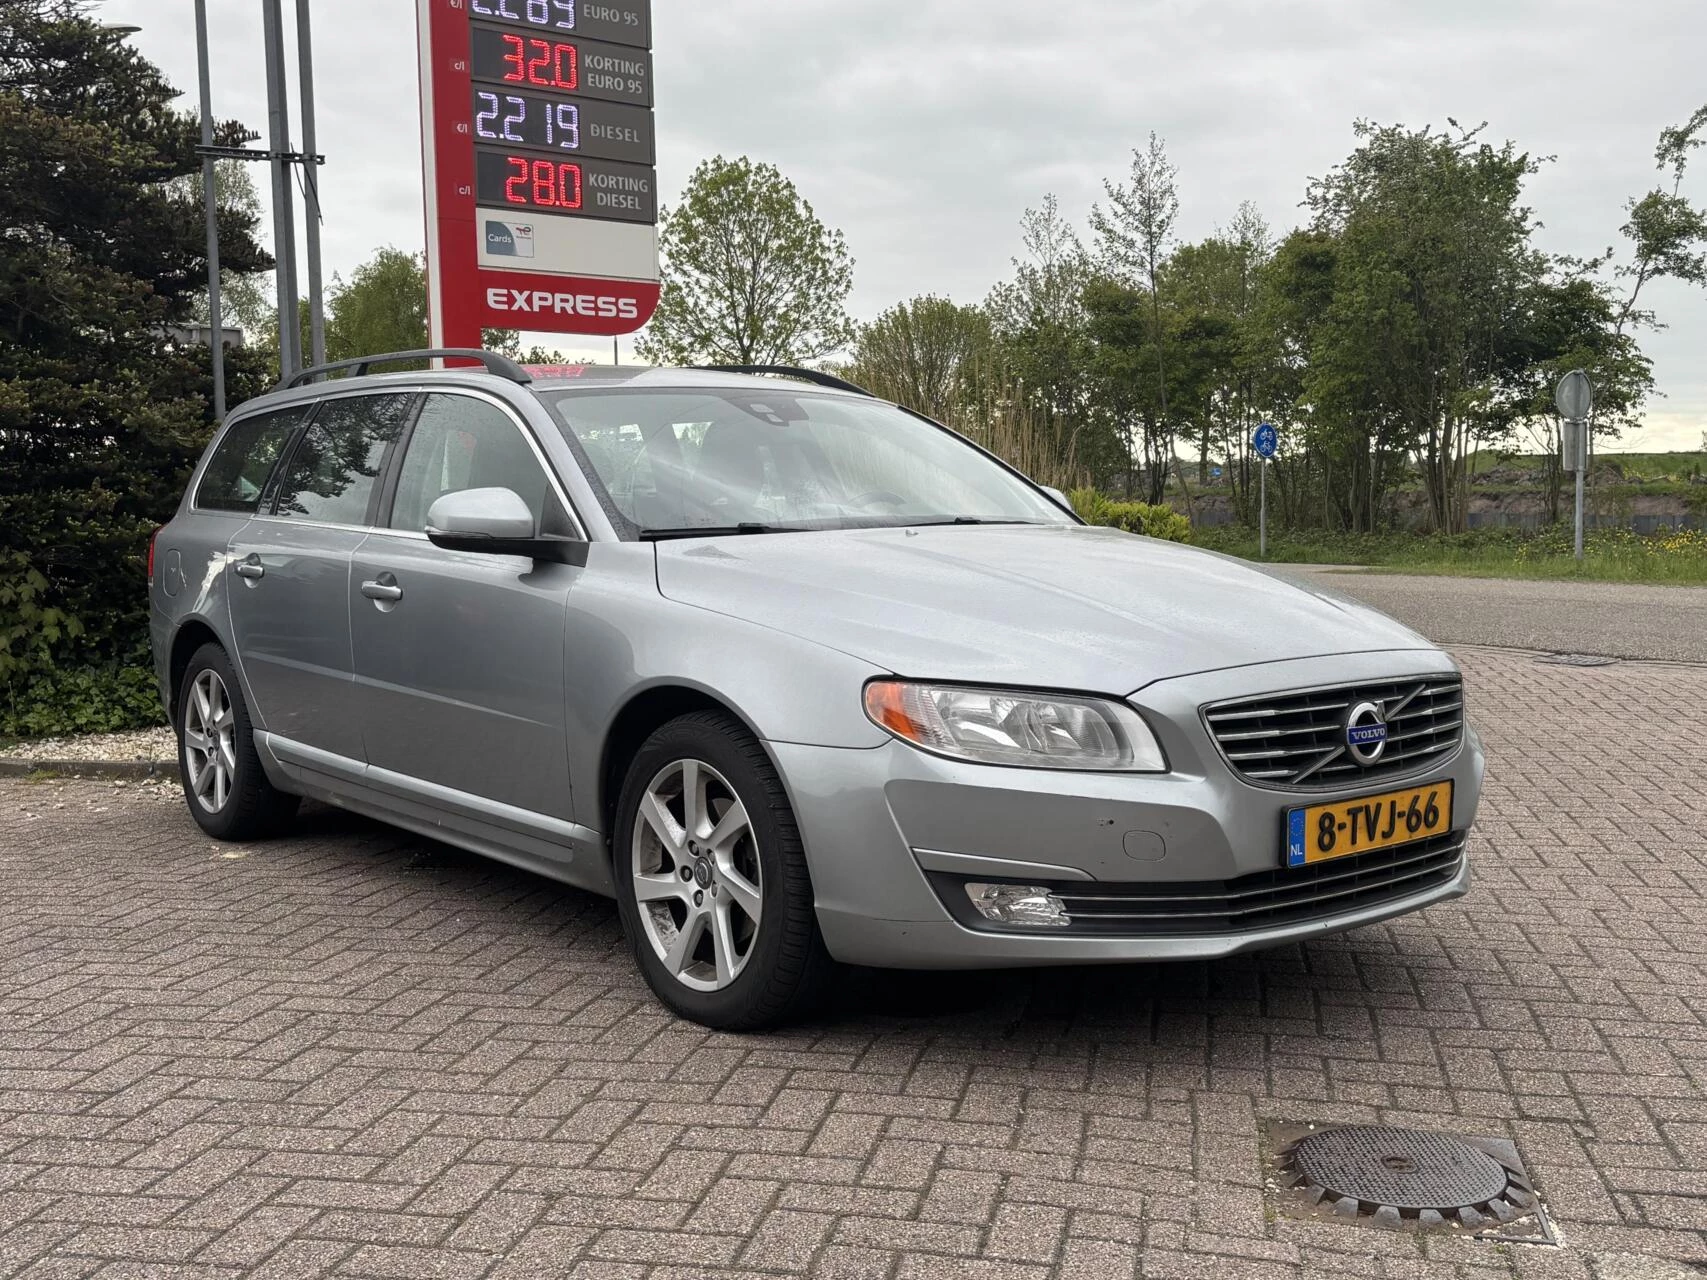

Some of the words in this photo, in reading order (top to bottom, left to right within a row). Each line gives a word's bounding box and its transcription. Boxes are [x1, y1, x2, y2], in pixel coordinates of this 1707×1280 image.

[583, 3, 620, 23] EURO
[623, 9, 639, 26] 95
[503, 34, 577, 90] 32.0
[584, 54, 645, 77] KORTING
[587, 73, 624, 92] EURO
[627, 78, 642, 94] 95
[476, 92, 580, 149] 2.219
[590, 123, 641, 143] DIESEL
[506, 156, 582, 208] 28.0
[588, 173, 649, 193] KORTING
[596, 192, 642, 210] DIESEL
[488, 233, 512, 244] Cards
[486, 288, 638, 319] EXPRESS
[1351, 728, 1386, 740] VOLVO
[1317, 791, 1440, 853] 8-TVJ-66
[1290, 843, 1303, 856] NL
